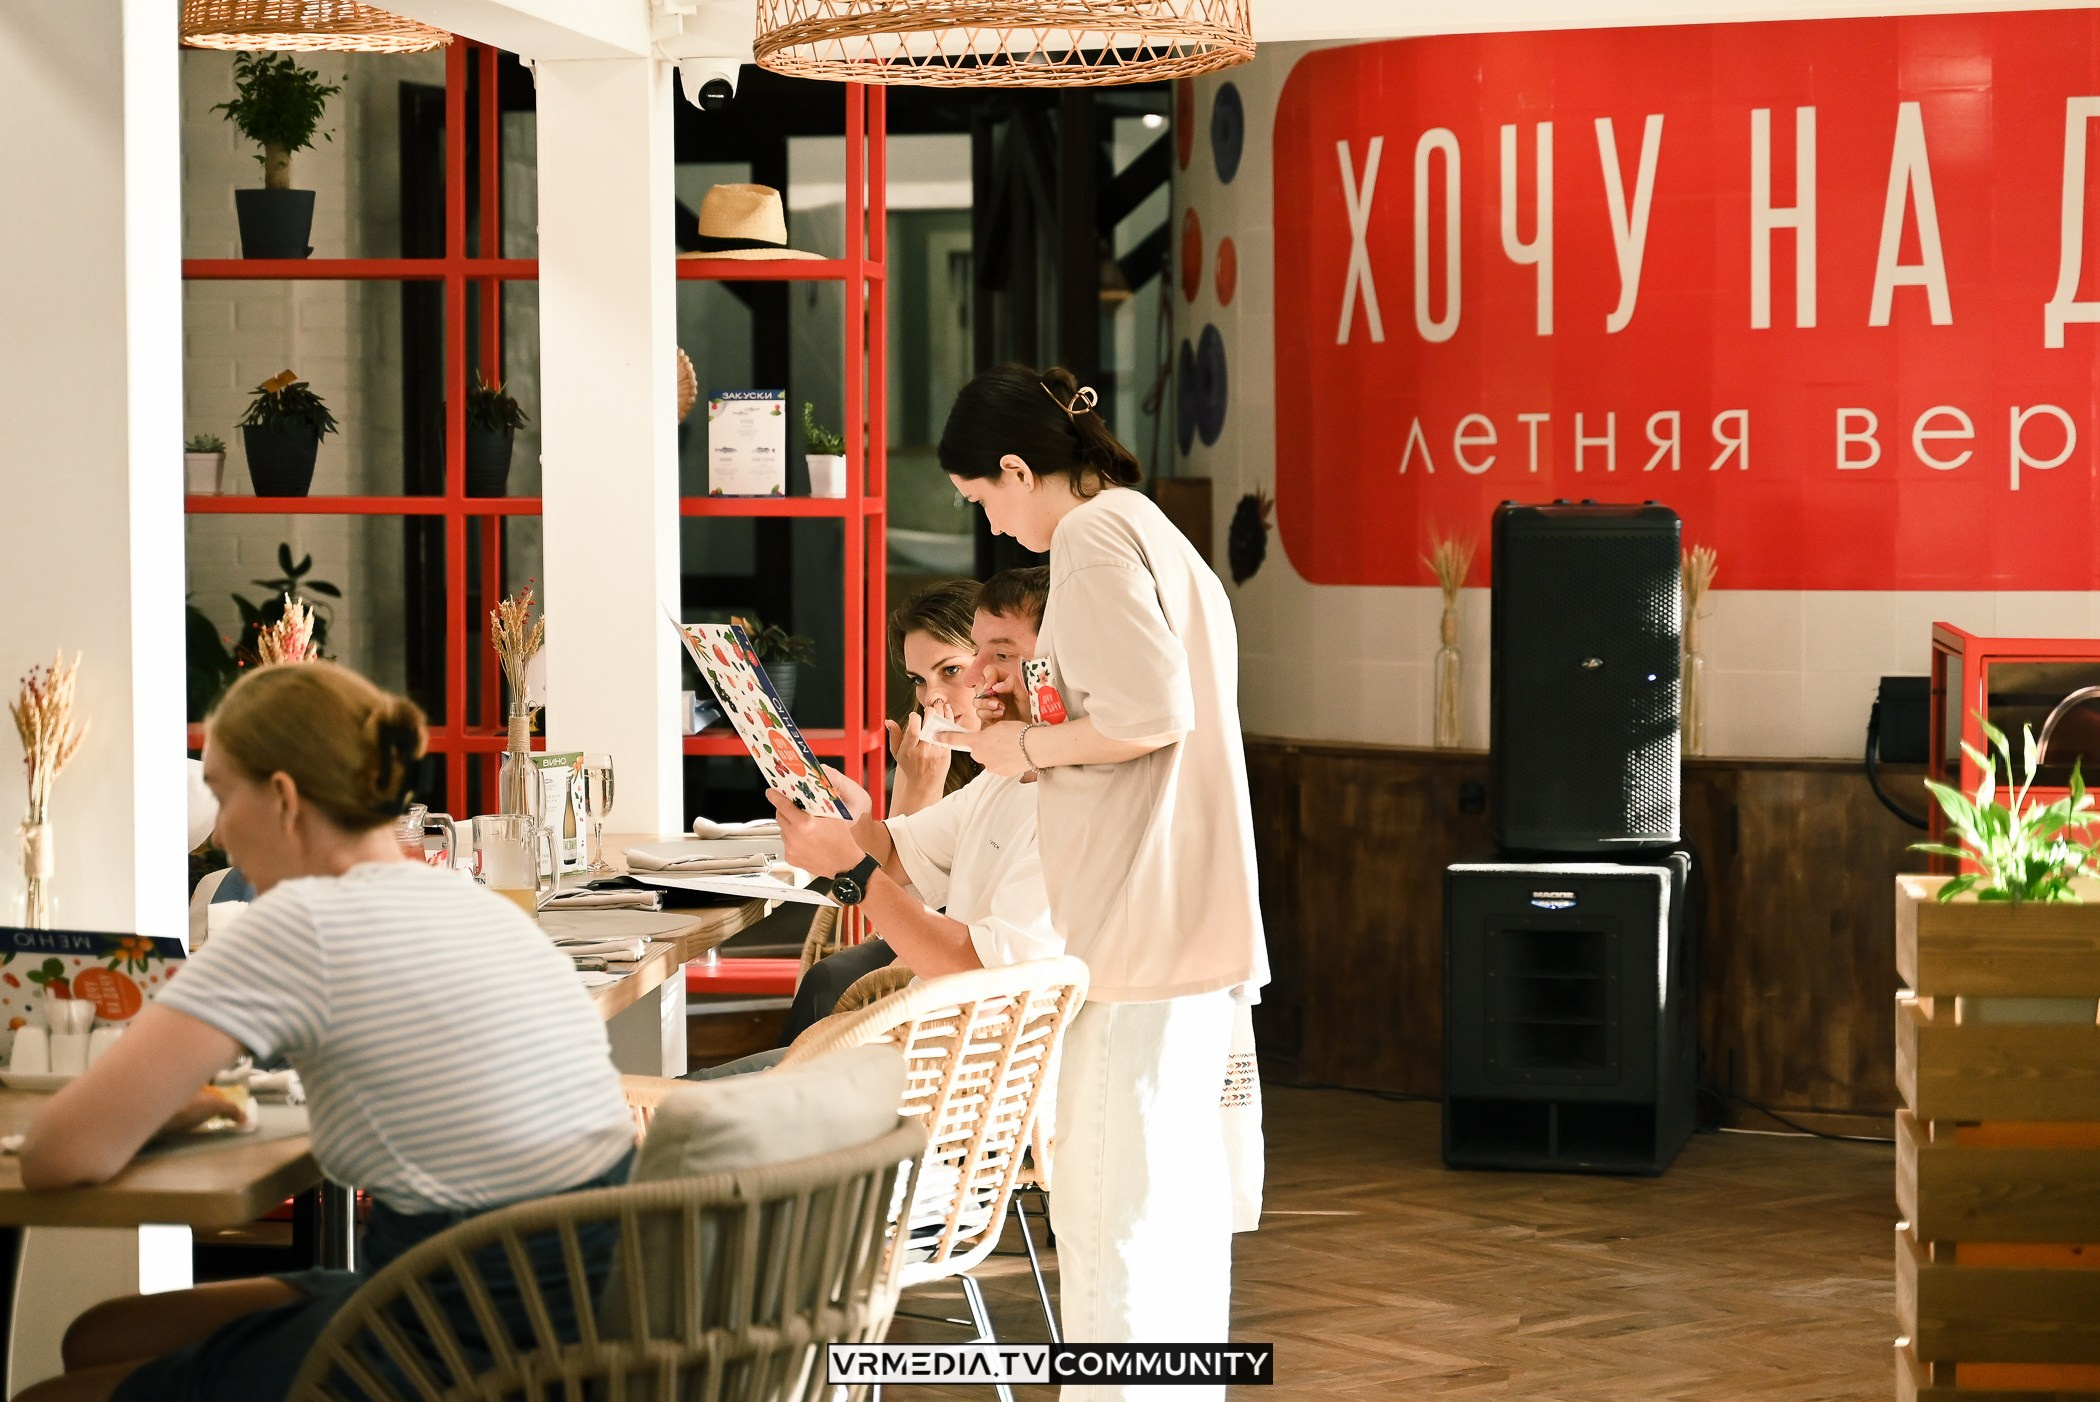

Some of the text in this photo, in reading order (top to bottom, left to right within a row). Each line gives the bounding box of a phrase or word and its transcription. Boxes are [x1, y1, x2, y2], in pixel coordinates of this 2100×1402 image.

[1336, 113, 1664, 345] ХОЧУ
[1751, 100, 1954, 330] НА
[721, 391, 773, 400] ЗАКУСКИ
[1399, 408, 1750, 476] летняя
[772, 697, 810, 753] МЕНЮ
[542, 757, 567, 767] ВИНО
[13, 932, 92, 949] МЕНЮ
